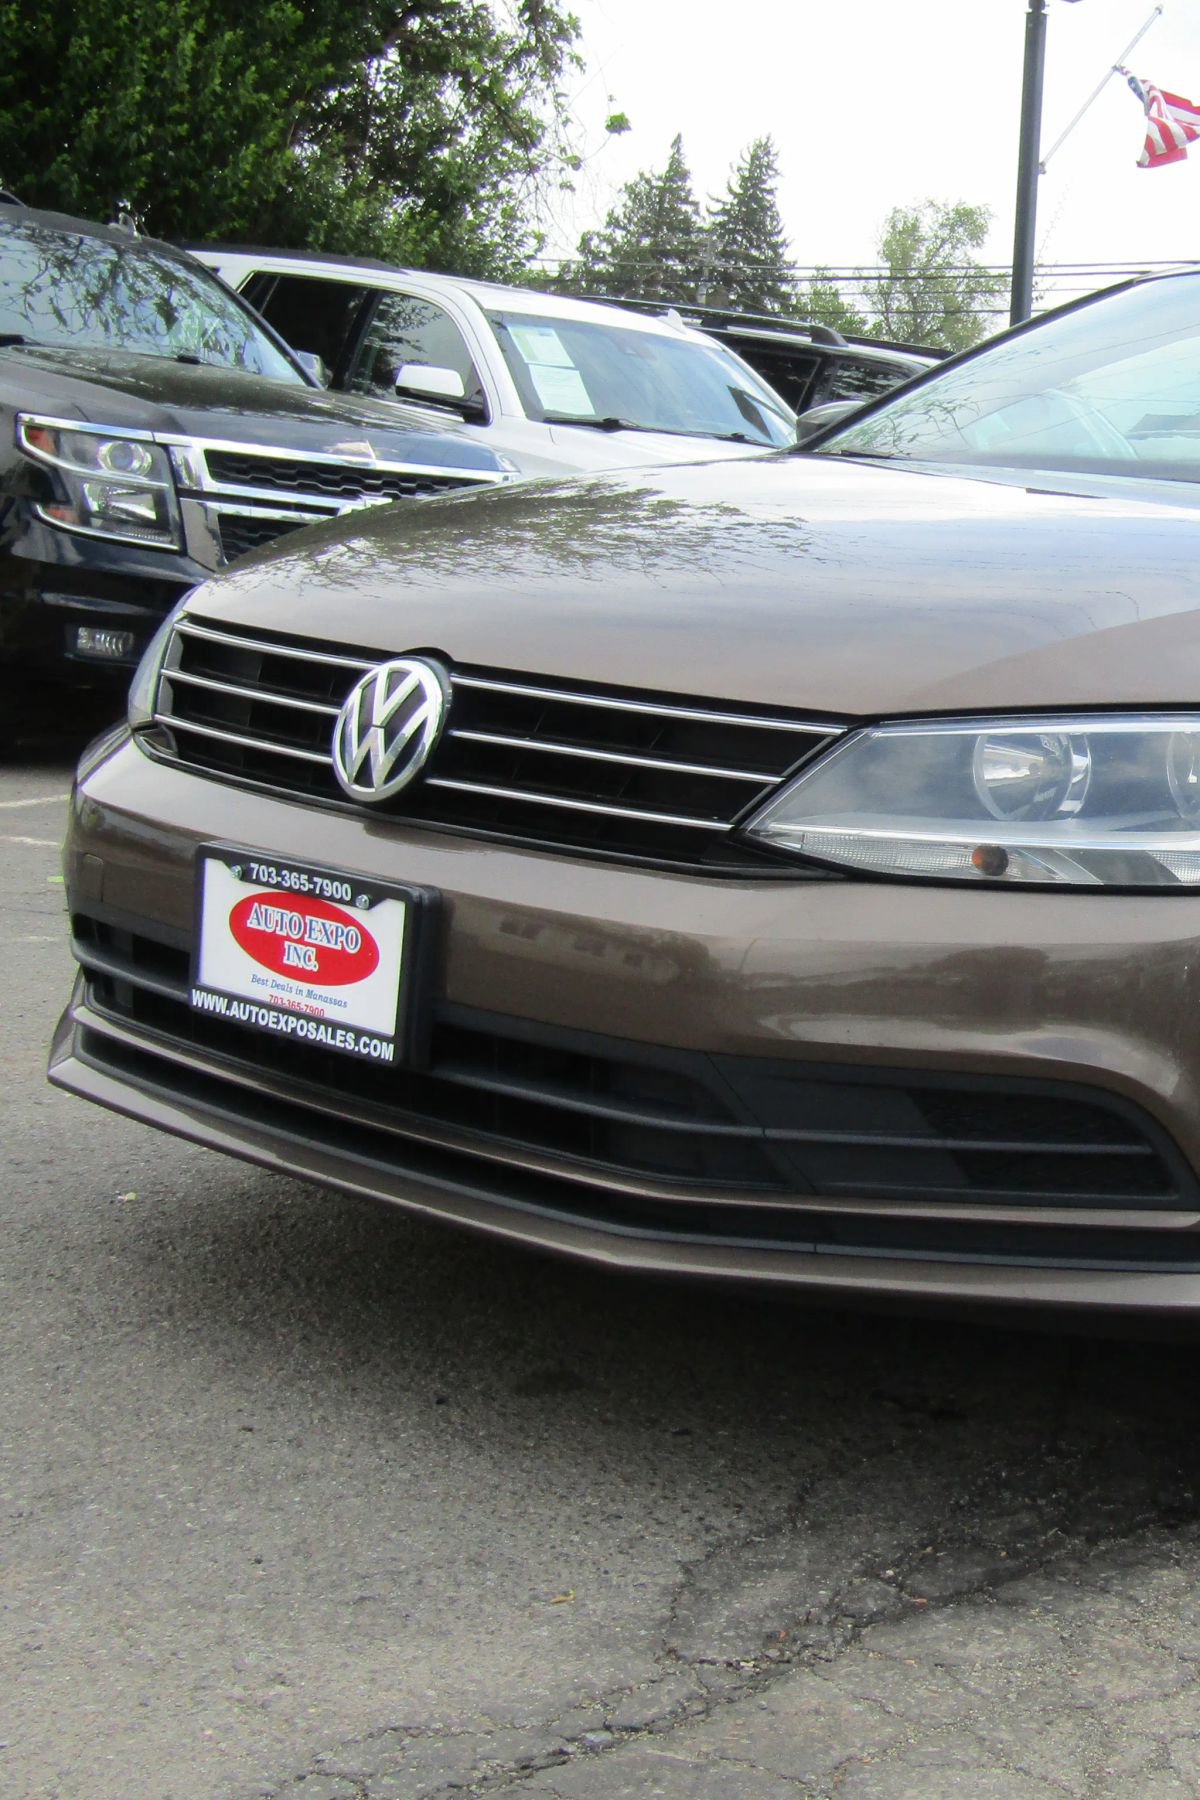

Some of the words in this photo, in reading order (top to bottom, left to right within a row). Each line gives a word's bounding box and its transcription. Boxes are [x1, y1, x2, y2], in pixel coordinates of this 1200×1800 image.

[250, 863, 352, 901] 703-365-7900
[248, 903, 303, 937] AUTO
[307, 916, 361, 953] EXPO
[284, 941, 319, 971] INC.
[251, 974, 269, 987] Best
[271, 979, 293, 994] Deals
[295, 985, 304, 997] in
[305, 989, 348, 1008] Manassas
[268, 994, 325, 1017] 703-365-7900
[191, 988, 395, 1061] WWW.AUTOEXPOSALES.COM
